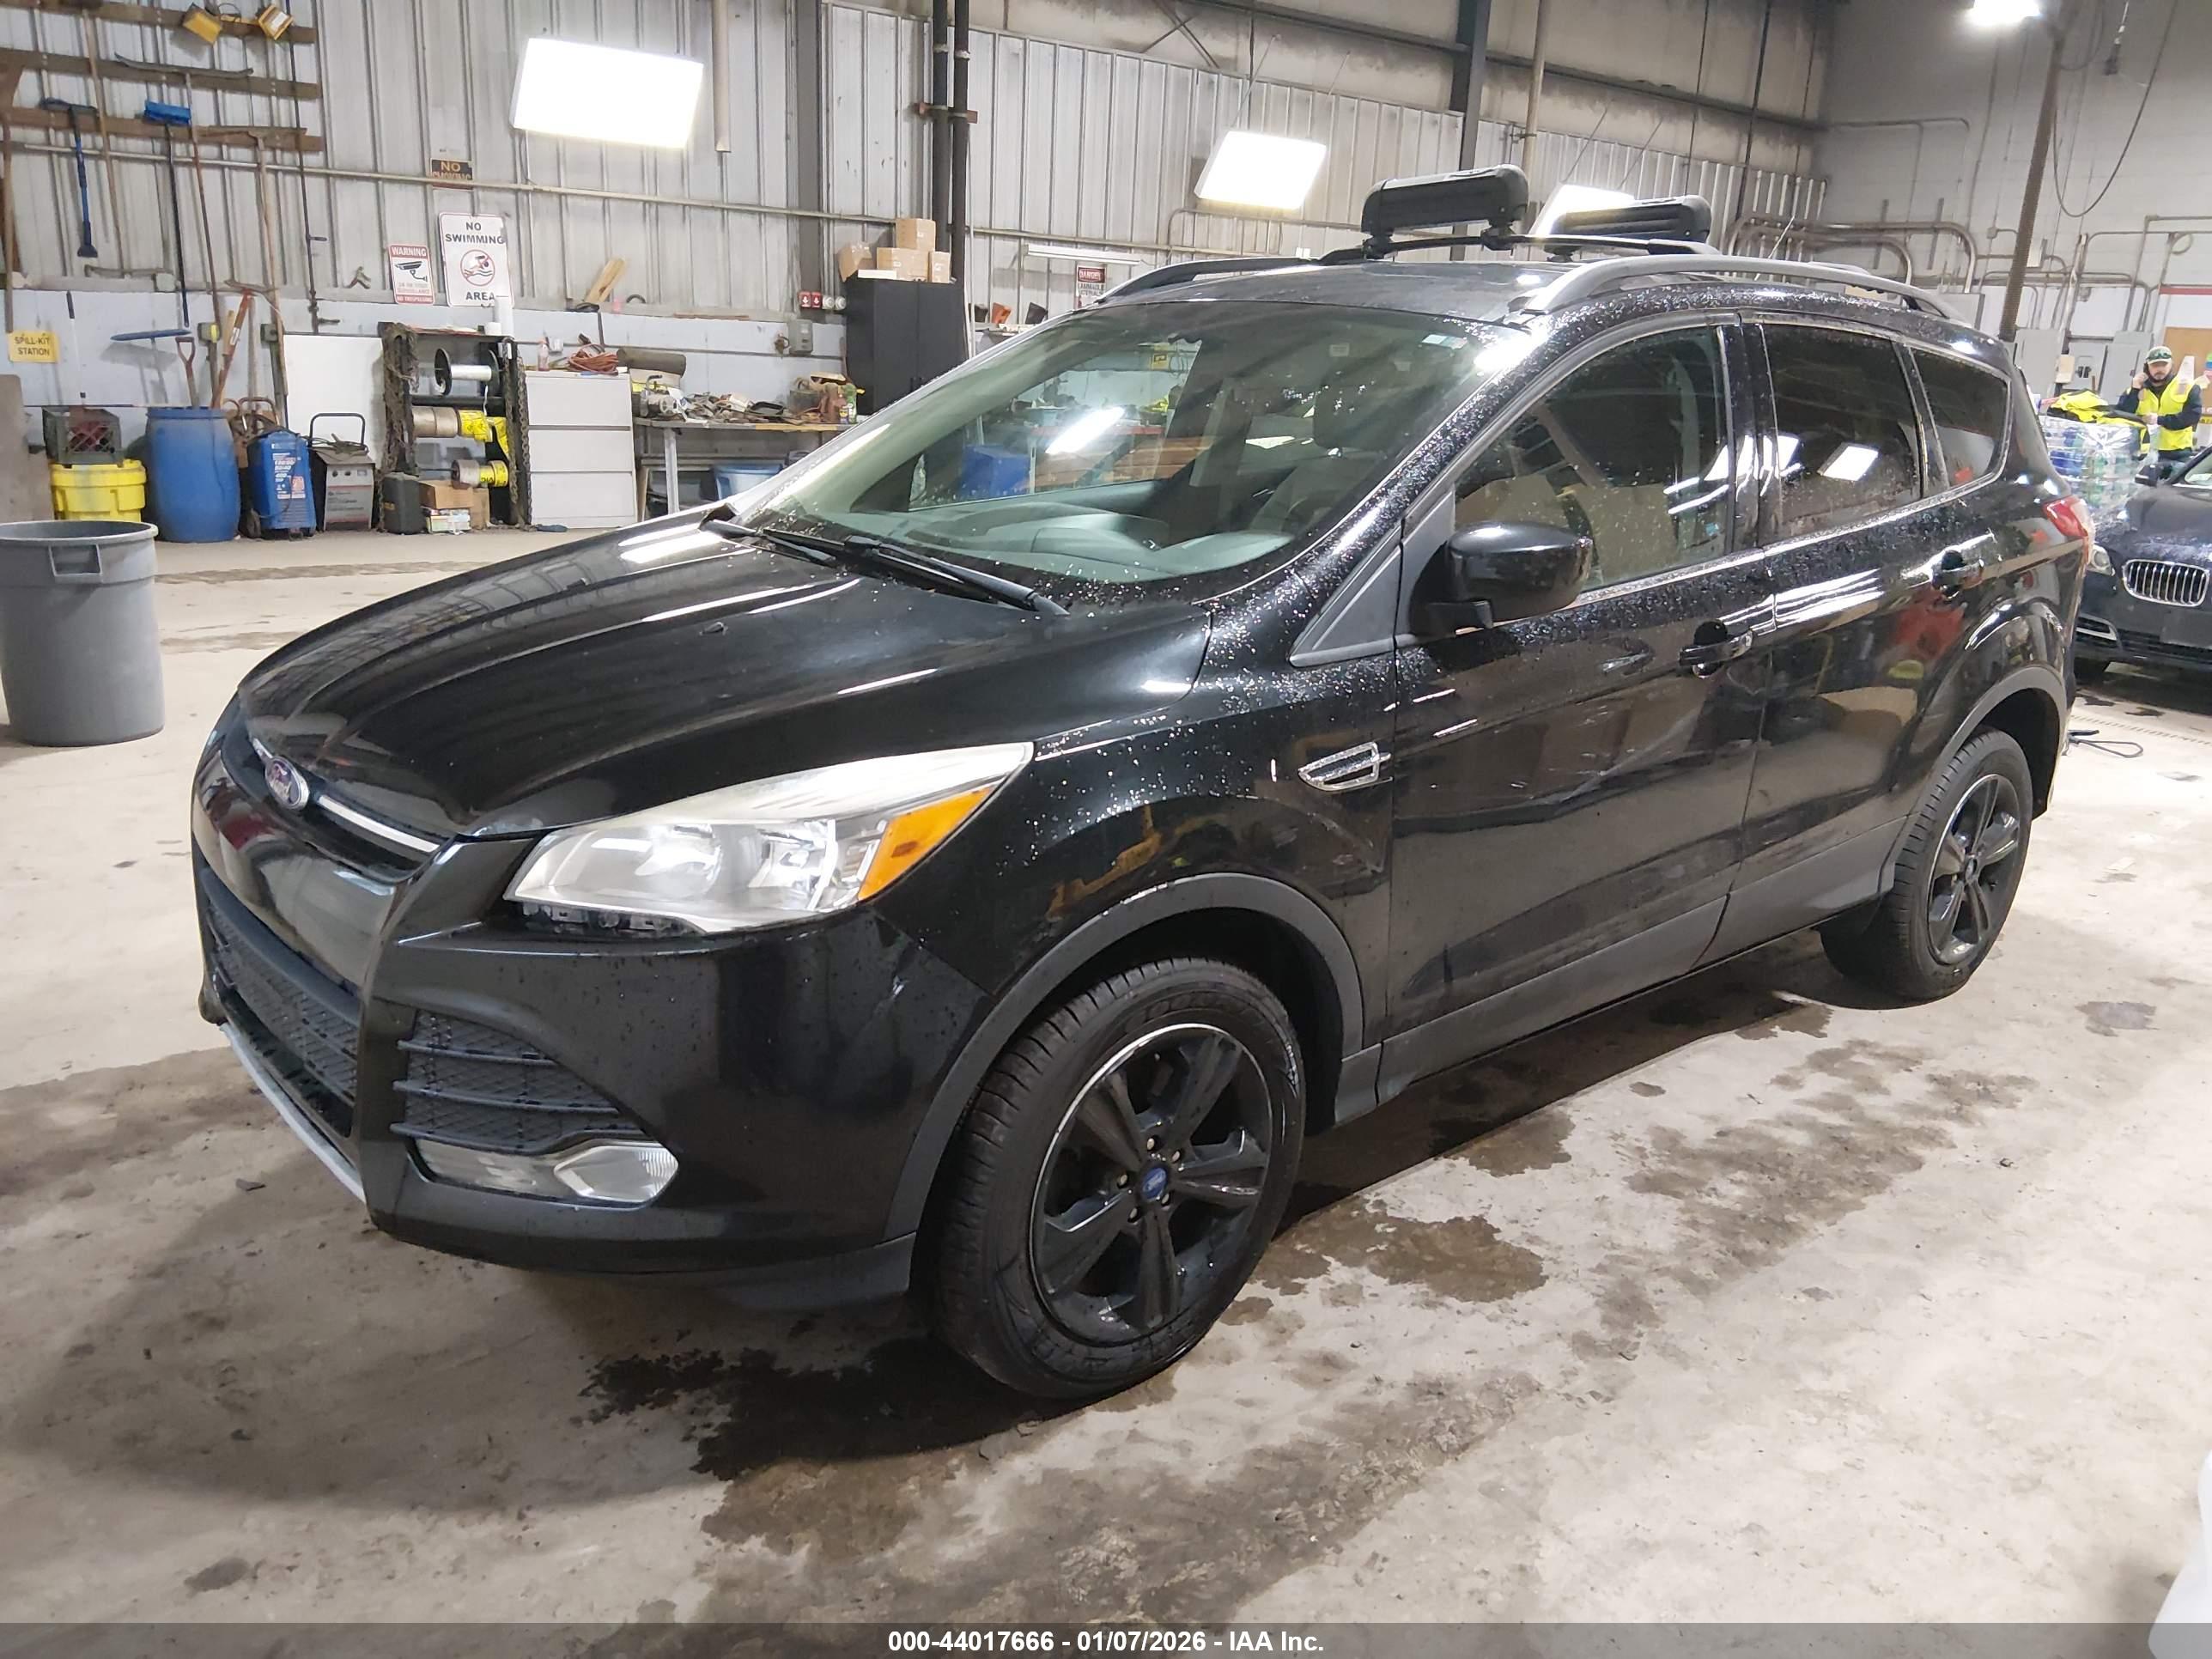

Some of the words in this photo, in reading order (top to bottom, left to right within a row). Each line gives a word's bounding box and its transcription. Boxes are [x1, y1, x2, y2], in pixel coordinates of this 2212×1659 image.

[441, 161, 461, 172] NO
[465, 222, 482, 231] NO
[445, 234, 506, 245] SWIMMING
[391, 246, 428, 257] WARNING
[465, 292, 495, 301] AREA
[17, 347, 50, 356] STATION
[270, 763, 293, 805] Ford
